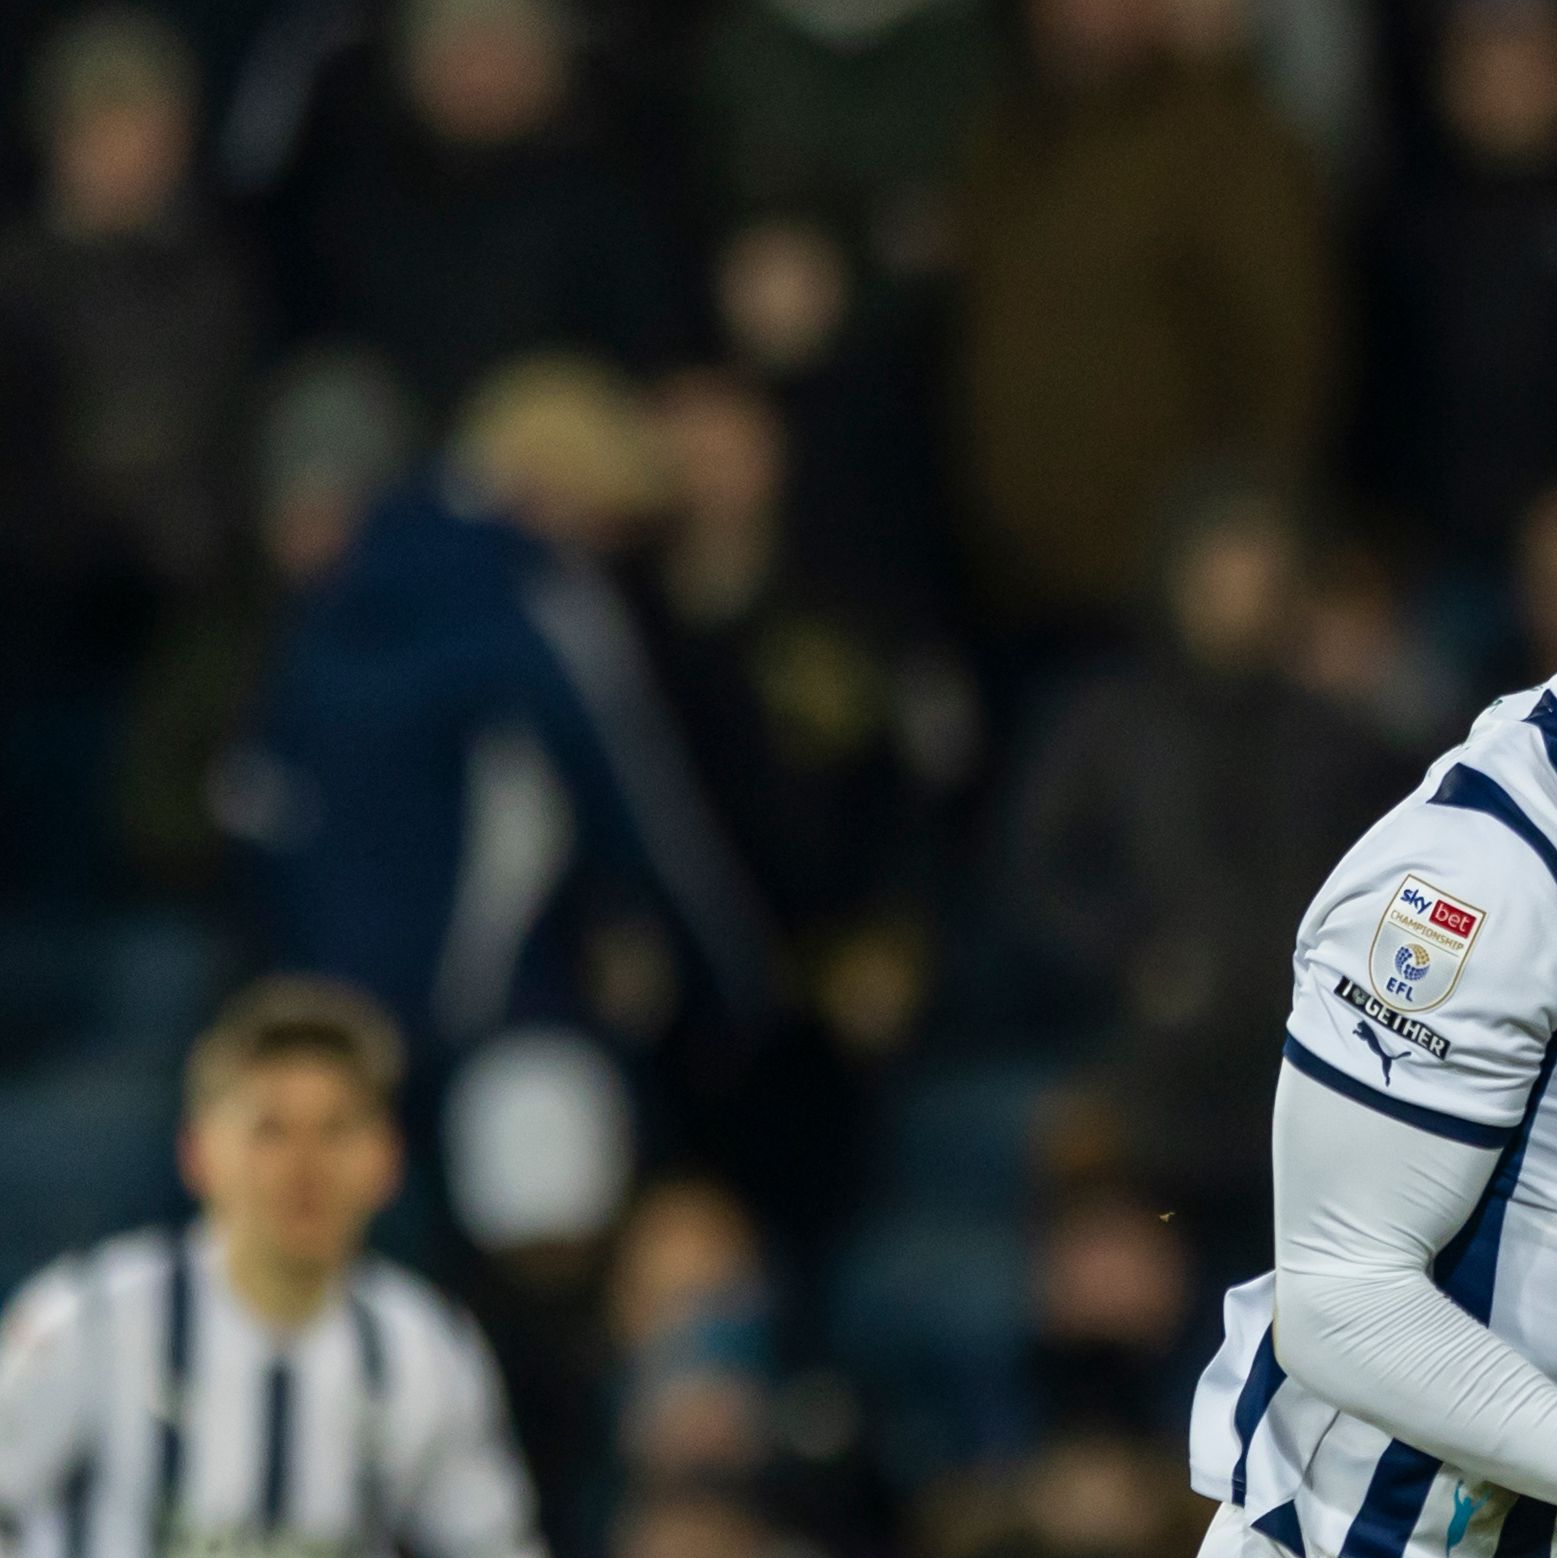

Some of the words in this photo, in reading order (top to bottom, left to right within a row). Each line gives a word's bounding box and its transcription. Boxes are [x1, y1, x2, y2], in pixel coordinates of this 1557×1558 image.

[1390, 909, 1465, 950] CHAMPIONSHIP
[1400, 887, 1432, 914] sky
[1434, 903, 1472, 933] bet
[1386, 976, 1414, 1002] EFL
